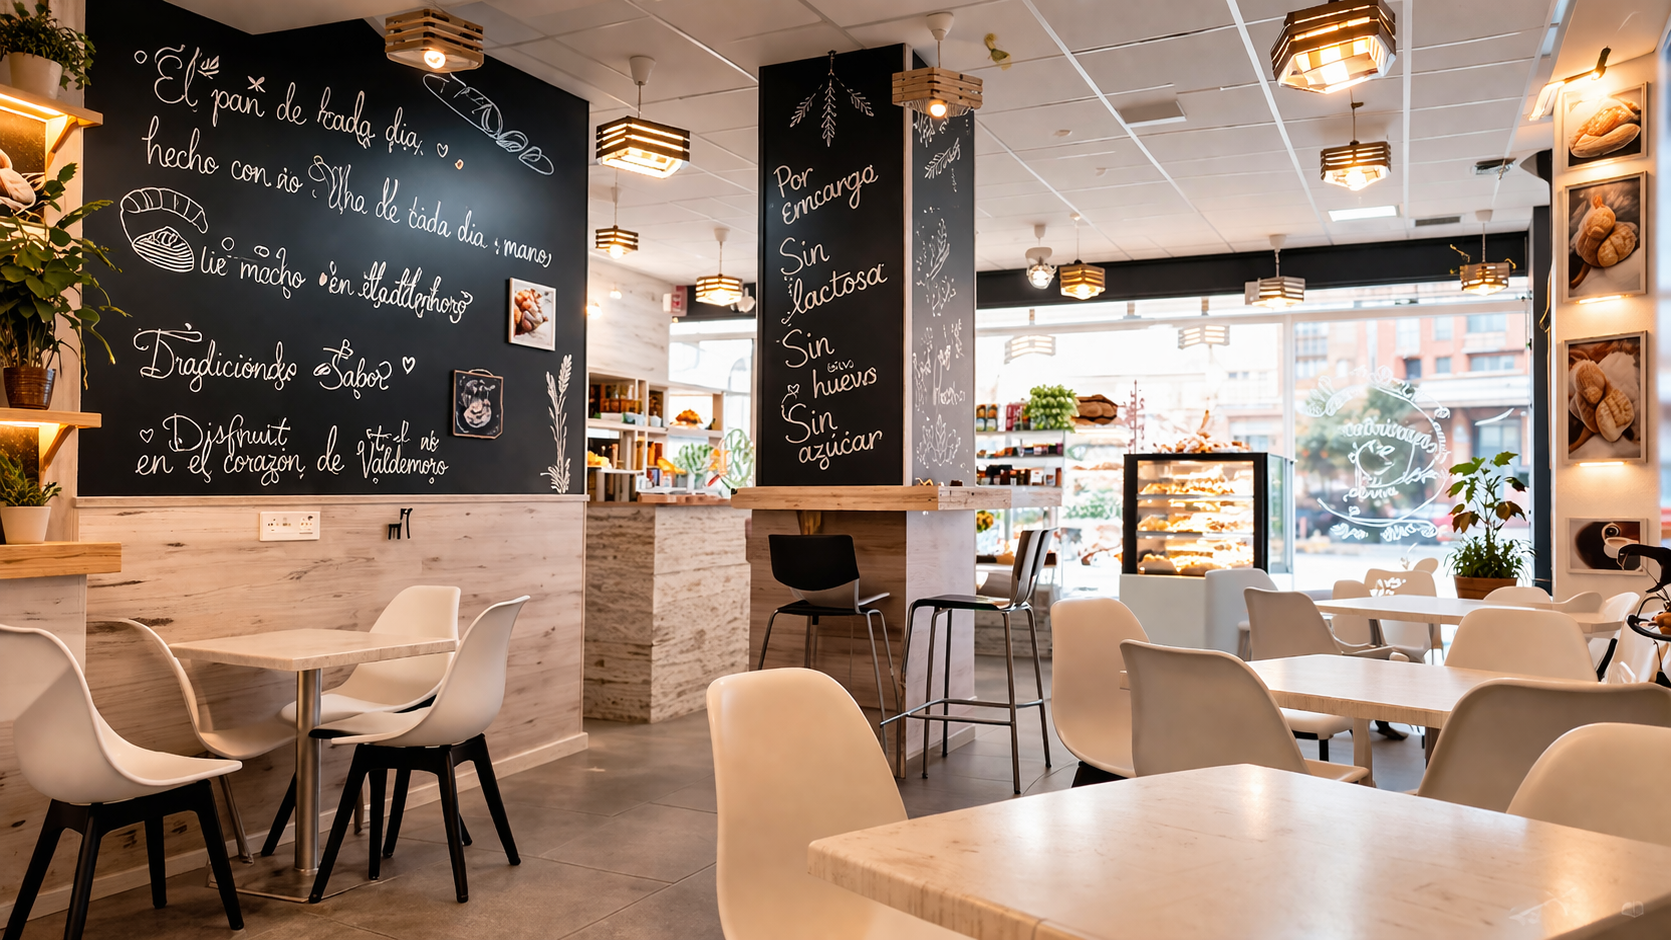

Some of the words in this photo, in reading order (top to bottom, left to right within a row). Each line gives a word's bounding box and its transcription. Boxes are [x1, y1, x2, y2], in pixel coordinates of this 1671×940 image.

[211, 88, 265, 127] pan
[276, 81, 307, 125] de
[141, 115, 219, 175] hecho
[231, 160, 272, 188] con
[773, 164, 814, 199] Por
[779, 236, 831, 276] Sin
[781, 263, 888, 324] lactosa
[781, 328, 835, 368] Sin
[783, 402, 839, 444] Sin
[135, 454, 174, 476] en
[187, 438, 213, 484] el
[317, 424, 346, 476] de
[356, 440, 450, 479] Valdemoro
[798, 430, 884, 471] azúcar
